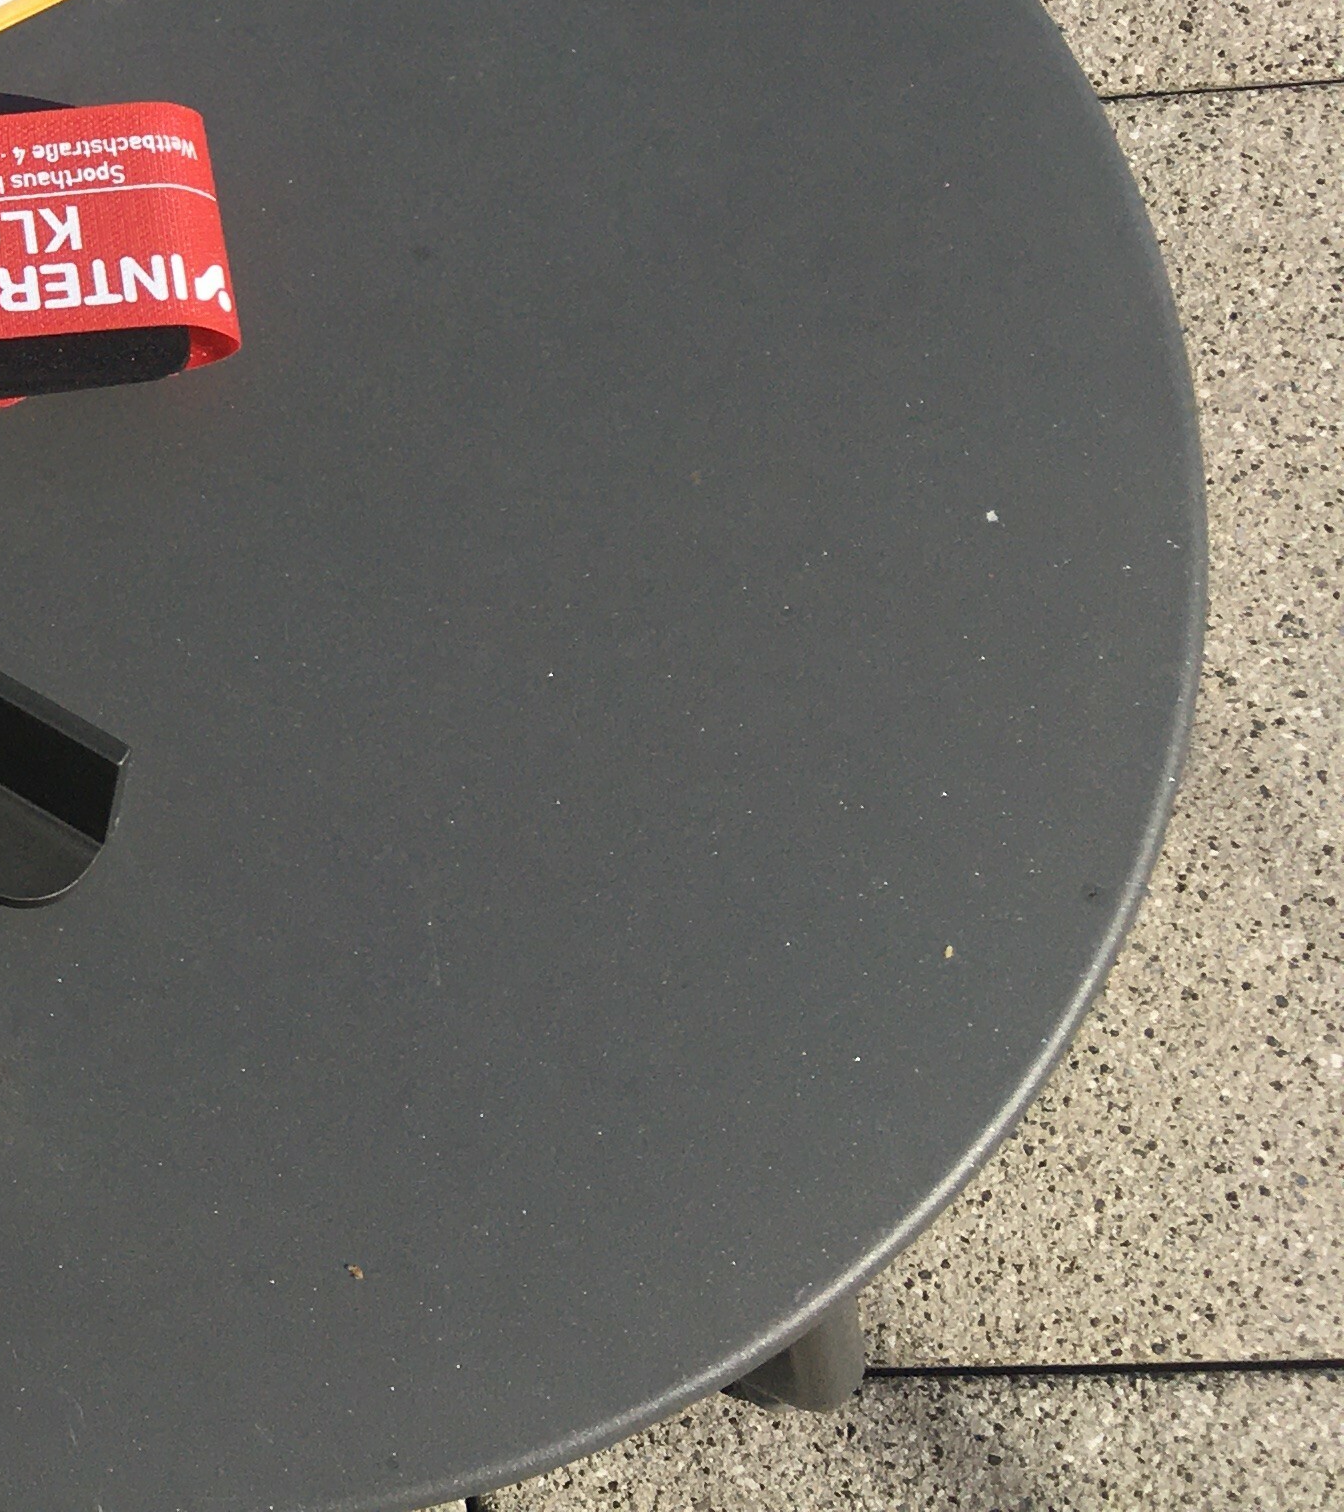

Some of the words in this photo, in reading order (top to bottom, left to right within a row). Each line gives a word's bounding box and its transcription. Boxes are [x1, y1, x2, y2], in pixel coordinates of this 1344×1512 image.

[11, 144, 26, 166] 4
[31, 132, 199, 164] Wettbachstraße
[9, 164, 126, 191] Sporthaus
